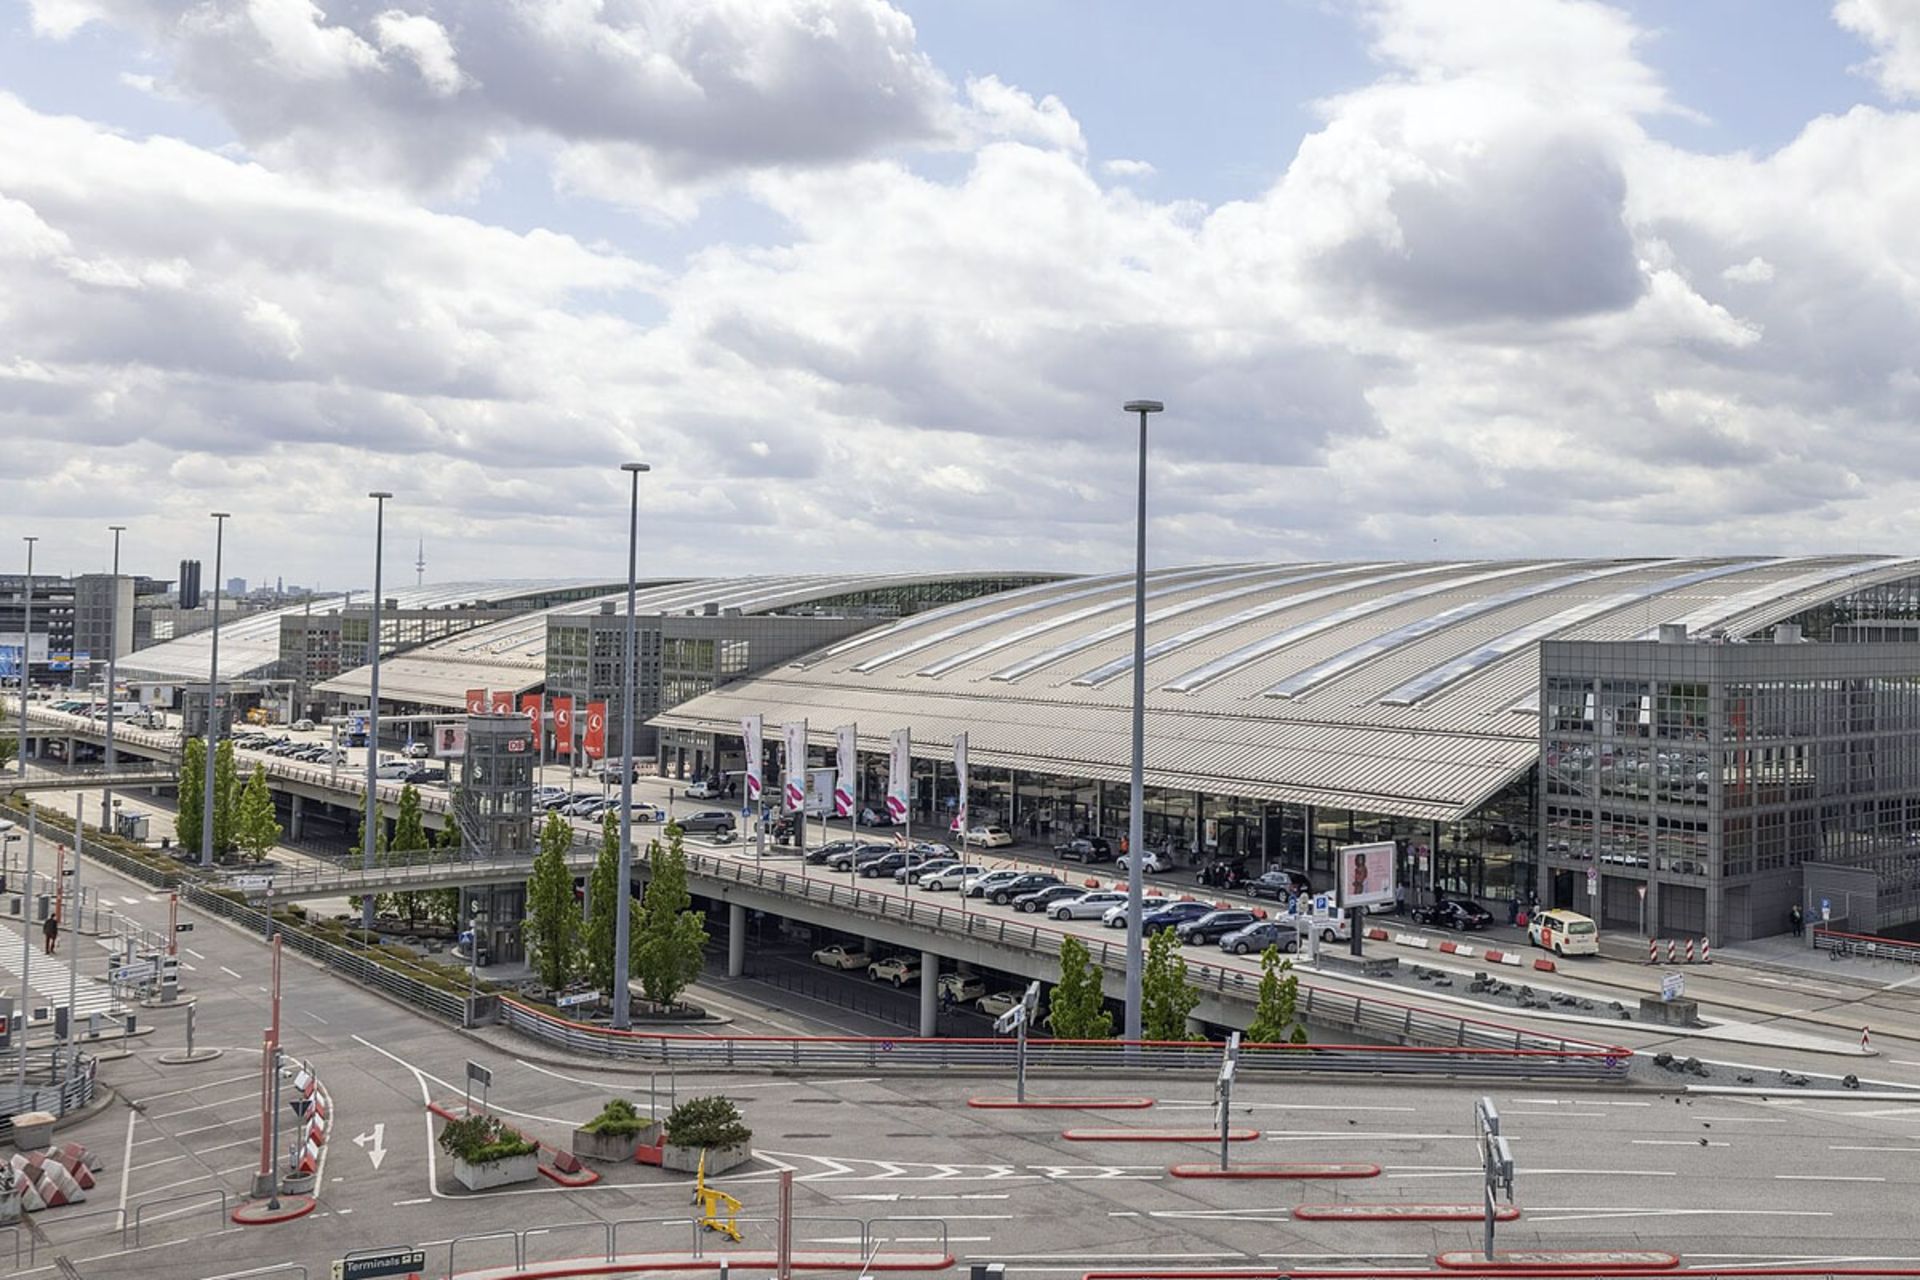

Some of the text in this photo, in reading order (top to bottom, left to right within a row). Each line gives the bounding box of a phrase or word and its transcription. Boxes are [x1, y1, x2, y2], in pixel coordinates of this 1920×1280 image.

[509, 740, 525, 751] DB
[473, 766, 482, 778] S
[471, 900, 478, 913] S
[347, 1257, 400, 1272] Terminals
